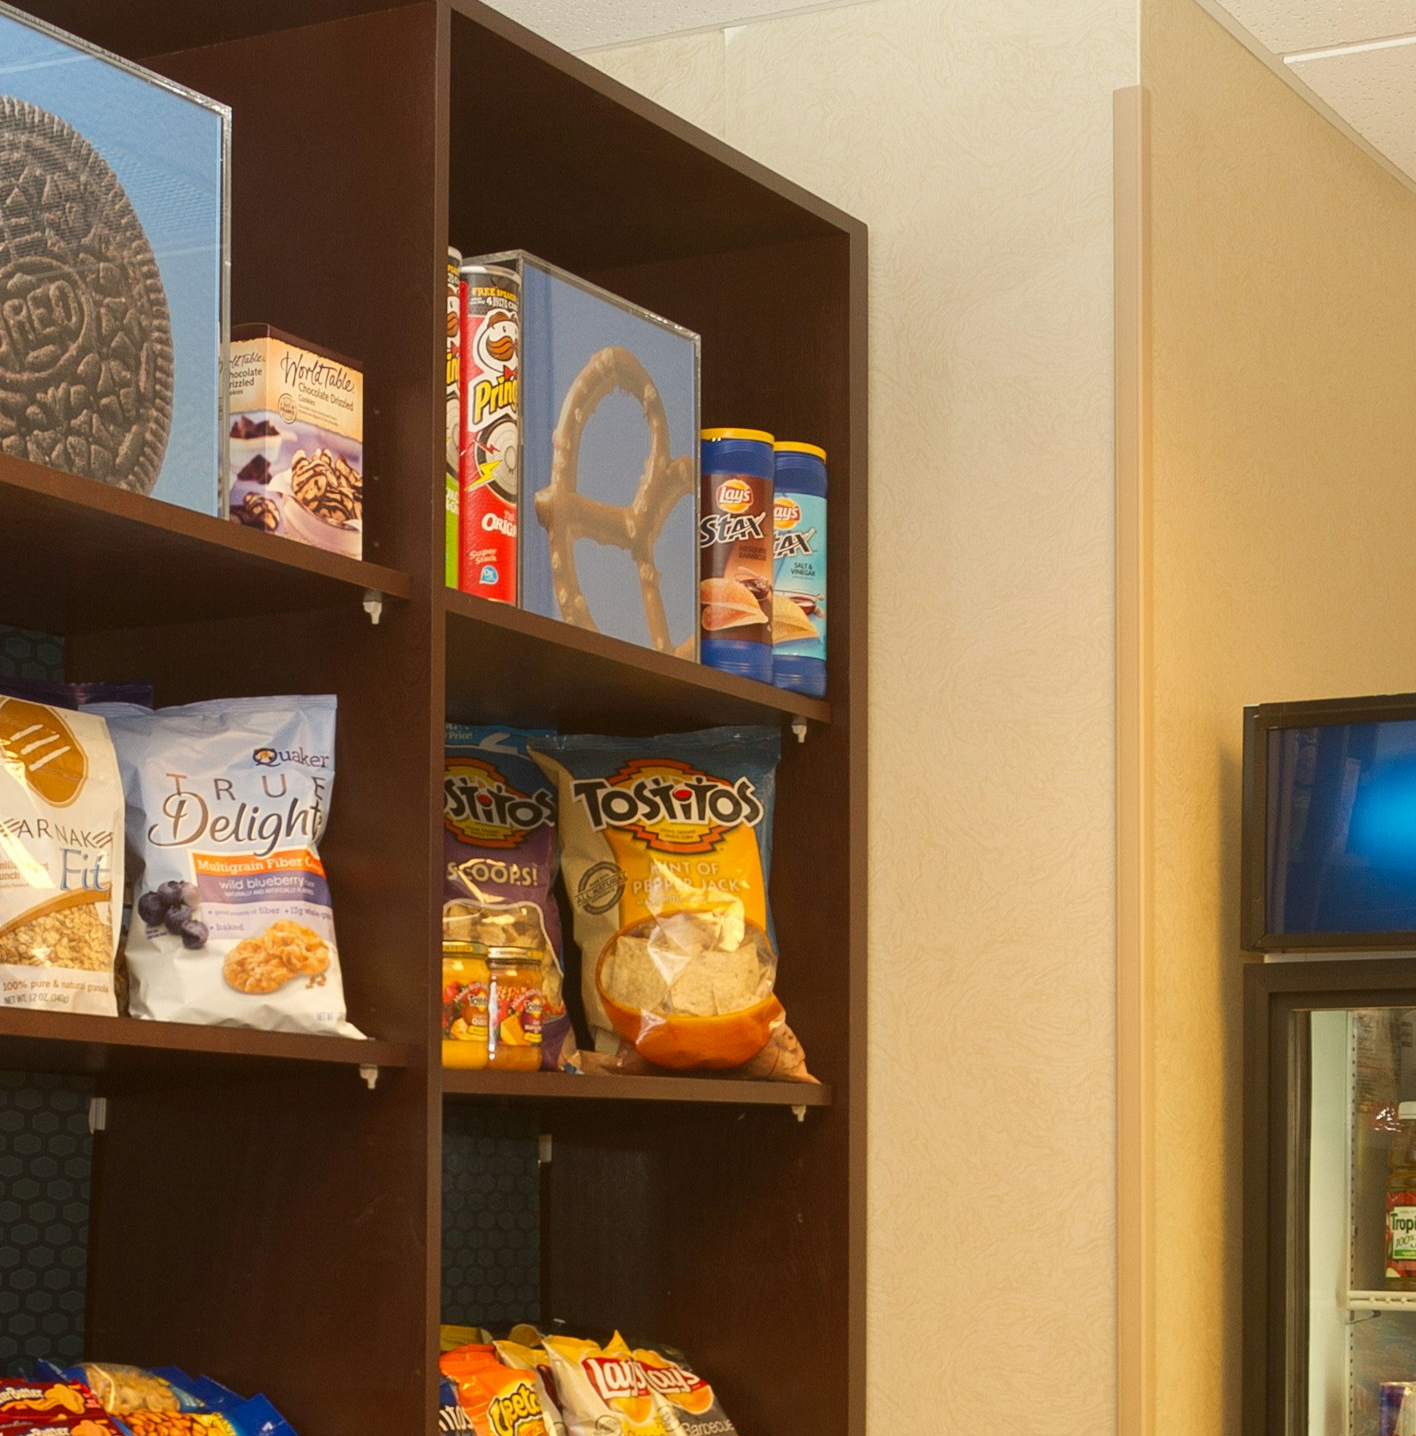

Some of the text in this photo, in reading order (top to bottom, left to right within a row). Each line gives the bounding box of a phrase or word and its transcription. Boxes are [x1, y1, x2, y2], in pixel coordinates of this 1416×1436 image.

[299, 382, 354, 412] Chocolate Drizzled
[717, 484, 752, 506] Lay's
[790, 567, 816, 577] VINEGAR
[252, 747, 329, 768] Quaker
[60, 848, 111, 891] Fit
[198, 856, 303, 873] Multigrain Fiber
[697, 862, 719, 875] OF
[219, 875, 305, 889] wild blueberry
[700, 878, 741, 894] JACK
[3, 980, 27, 991] 100%
[31, 979, 50, 990] pure
[53, 979, 59, 988] &
